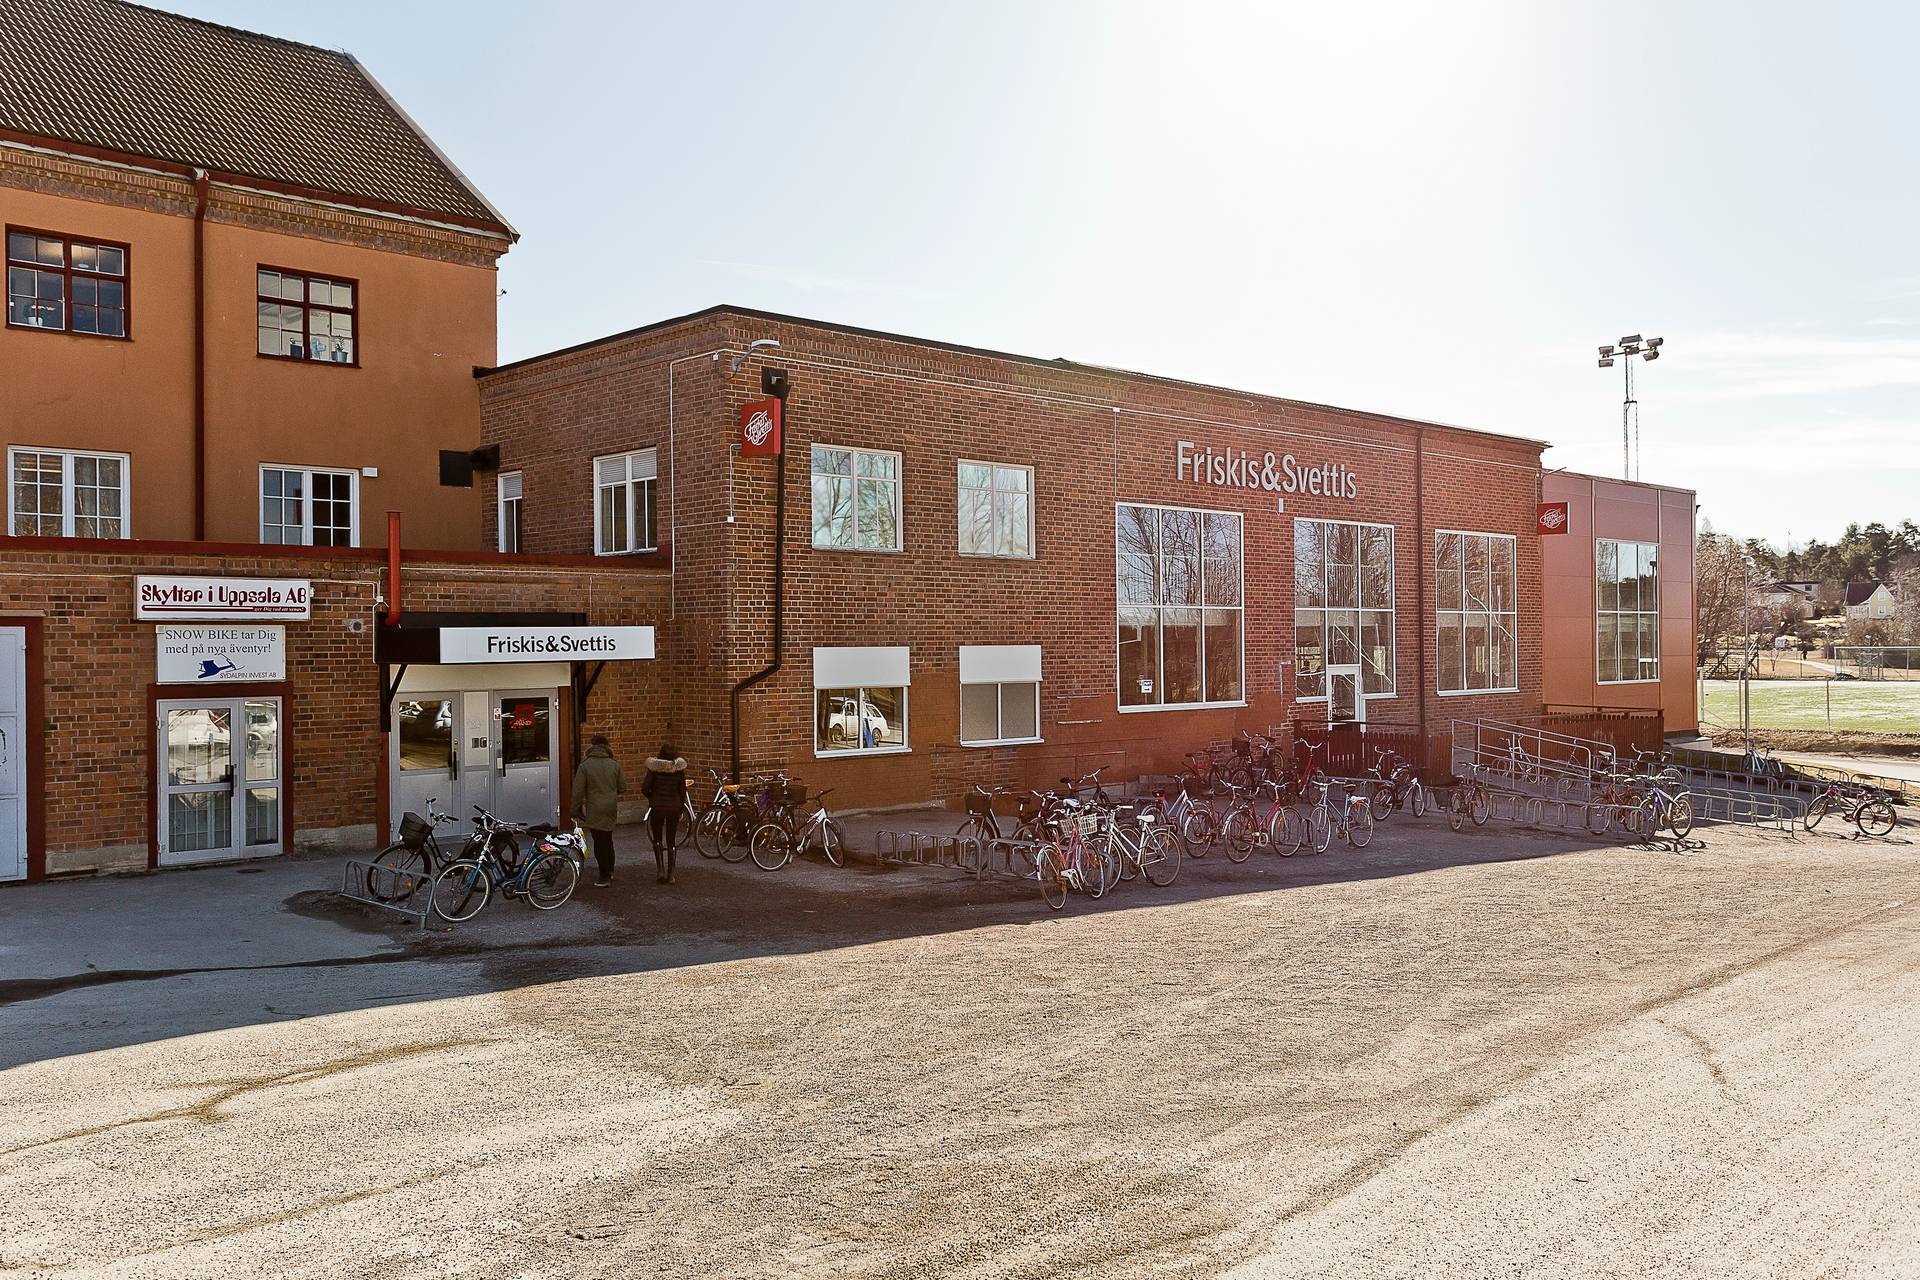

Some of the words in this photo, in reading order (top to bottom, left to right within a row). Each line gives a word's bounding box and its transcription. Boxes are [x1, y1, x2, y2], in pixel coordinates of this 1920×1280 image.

[1176, 440, 1357, 499] Friskis&Svettis
[142, 584, 203, 605] Skyltar
[208, 586, 213, 602] i
[219, 586, 281, 606] Uppsala
[285, 587, 307, 604] AB
[165, 629, 204, 640] SNOW
[208, 629, 238, 640] BIKE
[241, 631, 255, 640] tar
[258, 629, 277, 642] Dig
[165, 643, 189, 654] med
[191, 643, 204, 656] på
[207, 645, 227, 656] nya
[229, 643, 271, 656] äventyr!
[487, 635, 616, 653] Friskis&Svettis
[249, 671, 268, 679] INVEST
